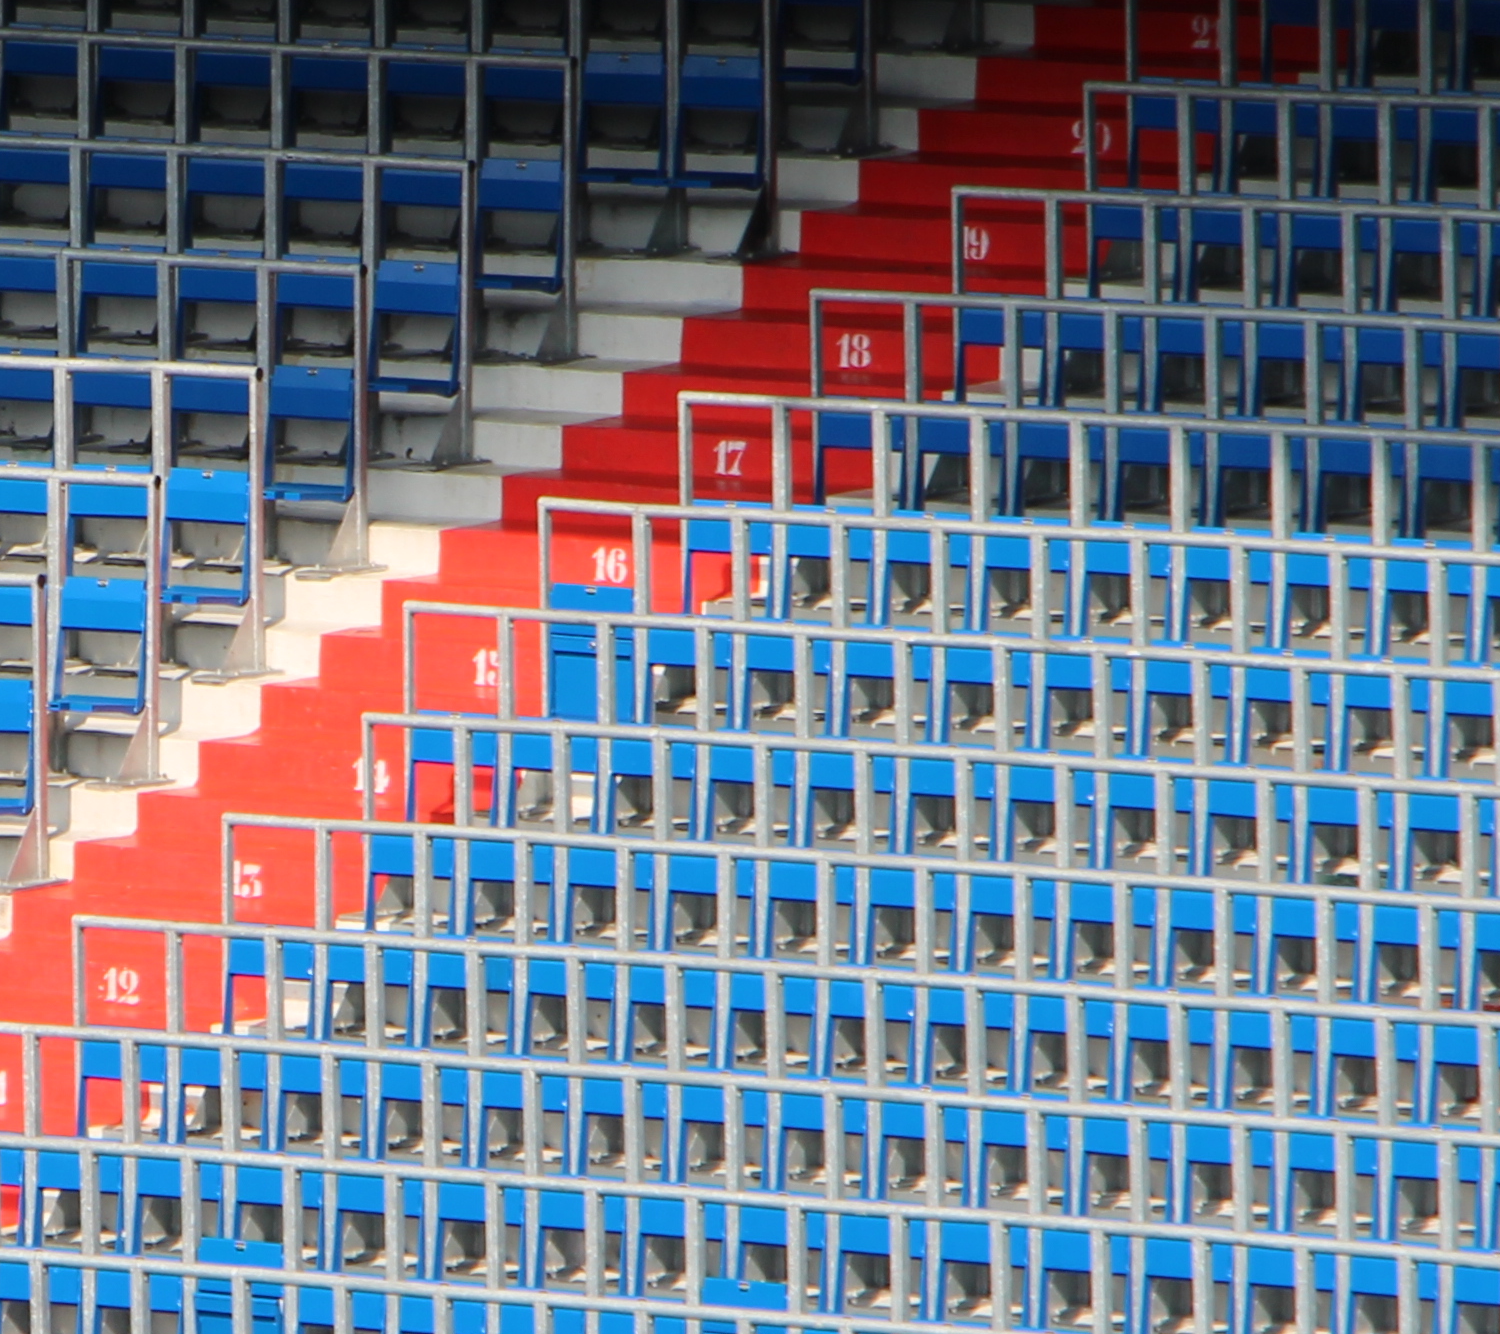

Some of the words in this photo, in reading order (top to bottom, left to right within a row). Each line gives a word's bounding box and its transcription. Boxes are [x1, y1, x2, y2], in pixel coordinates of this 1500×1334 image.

[836, 333, 872, 369] 18
[712, 440, 748, 477] 17
[591, 546, 628, 584] 16
[100, 967, 140, 1006] 12
